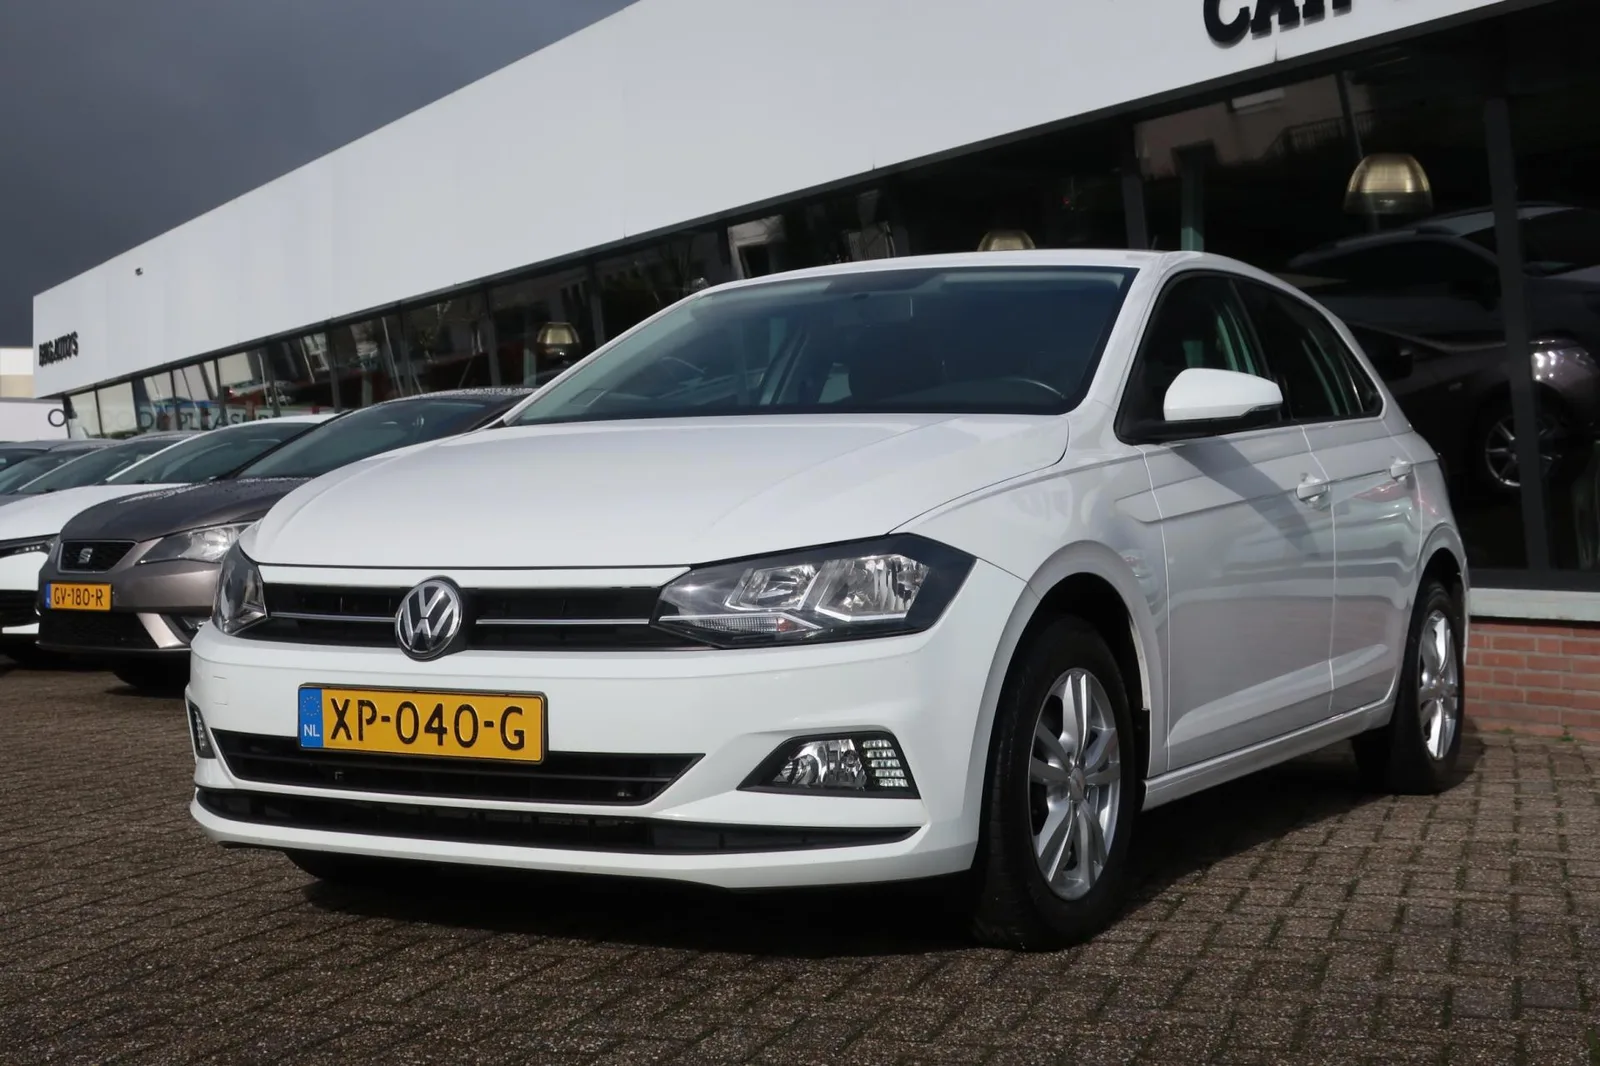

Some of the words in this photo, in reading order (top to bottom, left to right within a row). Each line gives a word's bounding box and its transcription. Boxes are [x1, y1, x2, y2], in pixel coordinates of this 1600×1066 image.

[54, 587, 103, 606] GV-180-R
[303, 723, 320, 738] NL
[330, 698, 525, 751] XP-040-G
